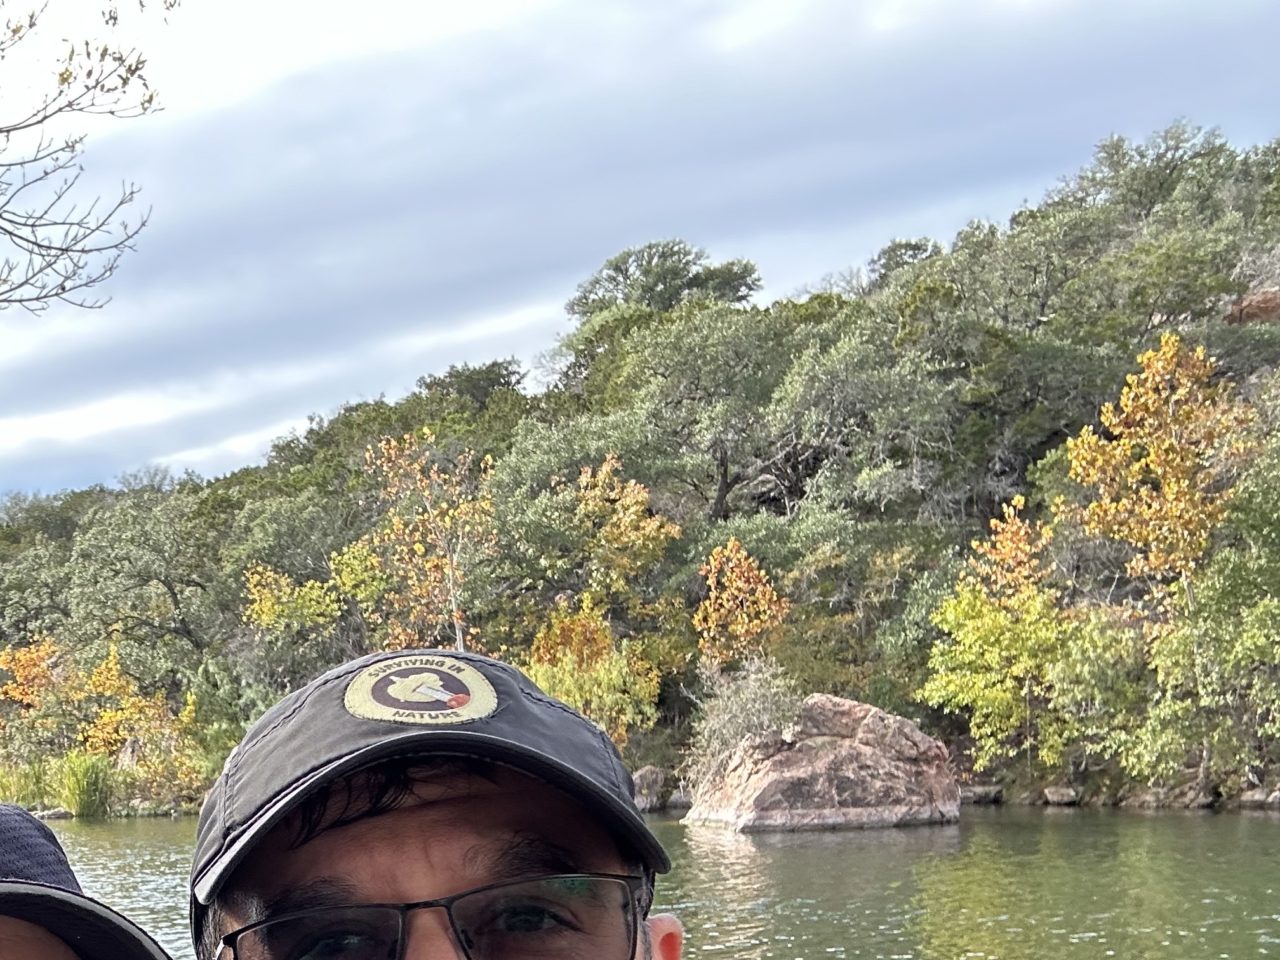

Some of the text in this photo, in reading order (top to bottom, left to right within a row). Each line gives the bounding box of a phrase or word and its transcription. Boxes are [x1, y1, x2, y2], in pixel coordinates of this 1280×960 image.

[369, 658, 466, 678] SURVIVING IN
[392, 710, 463, 719] NATURE
